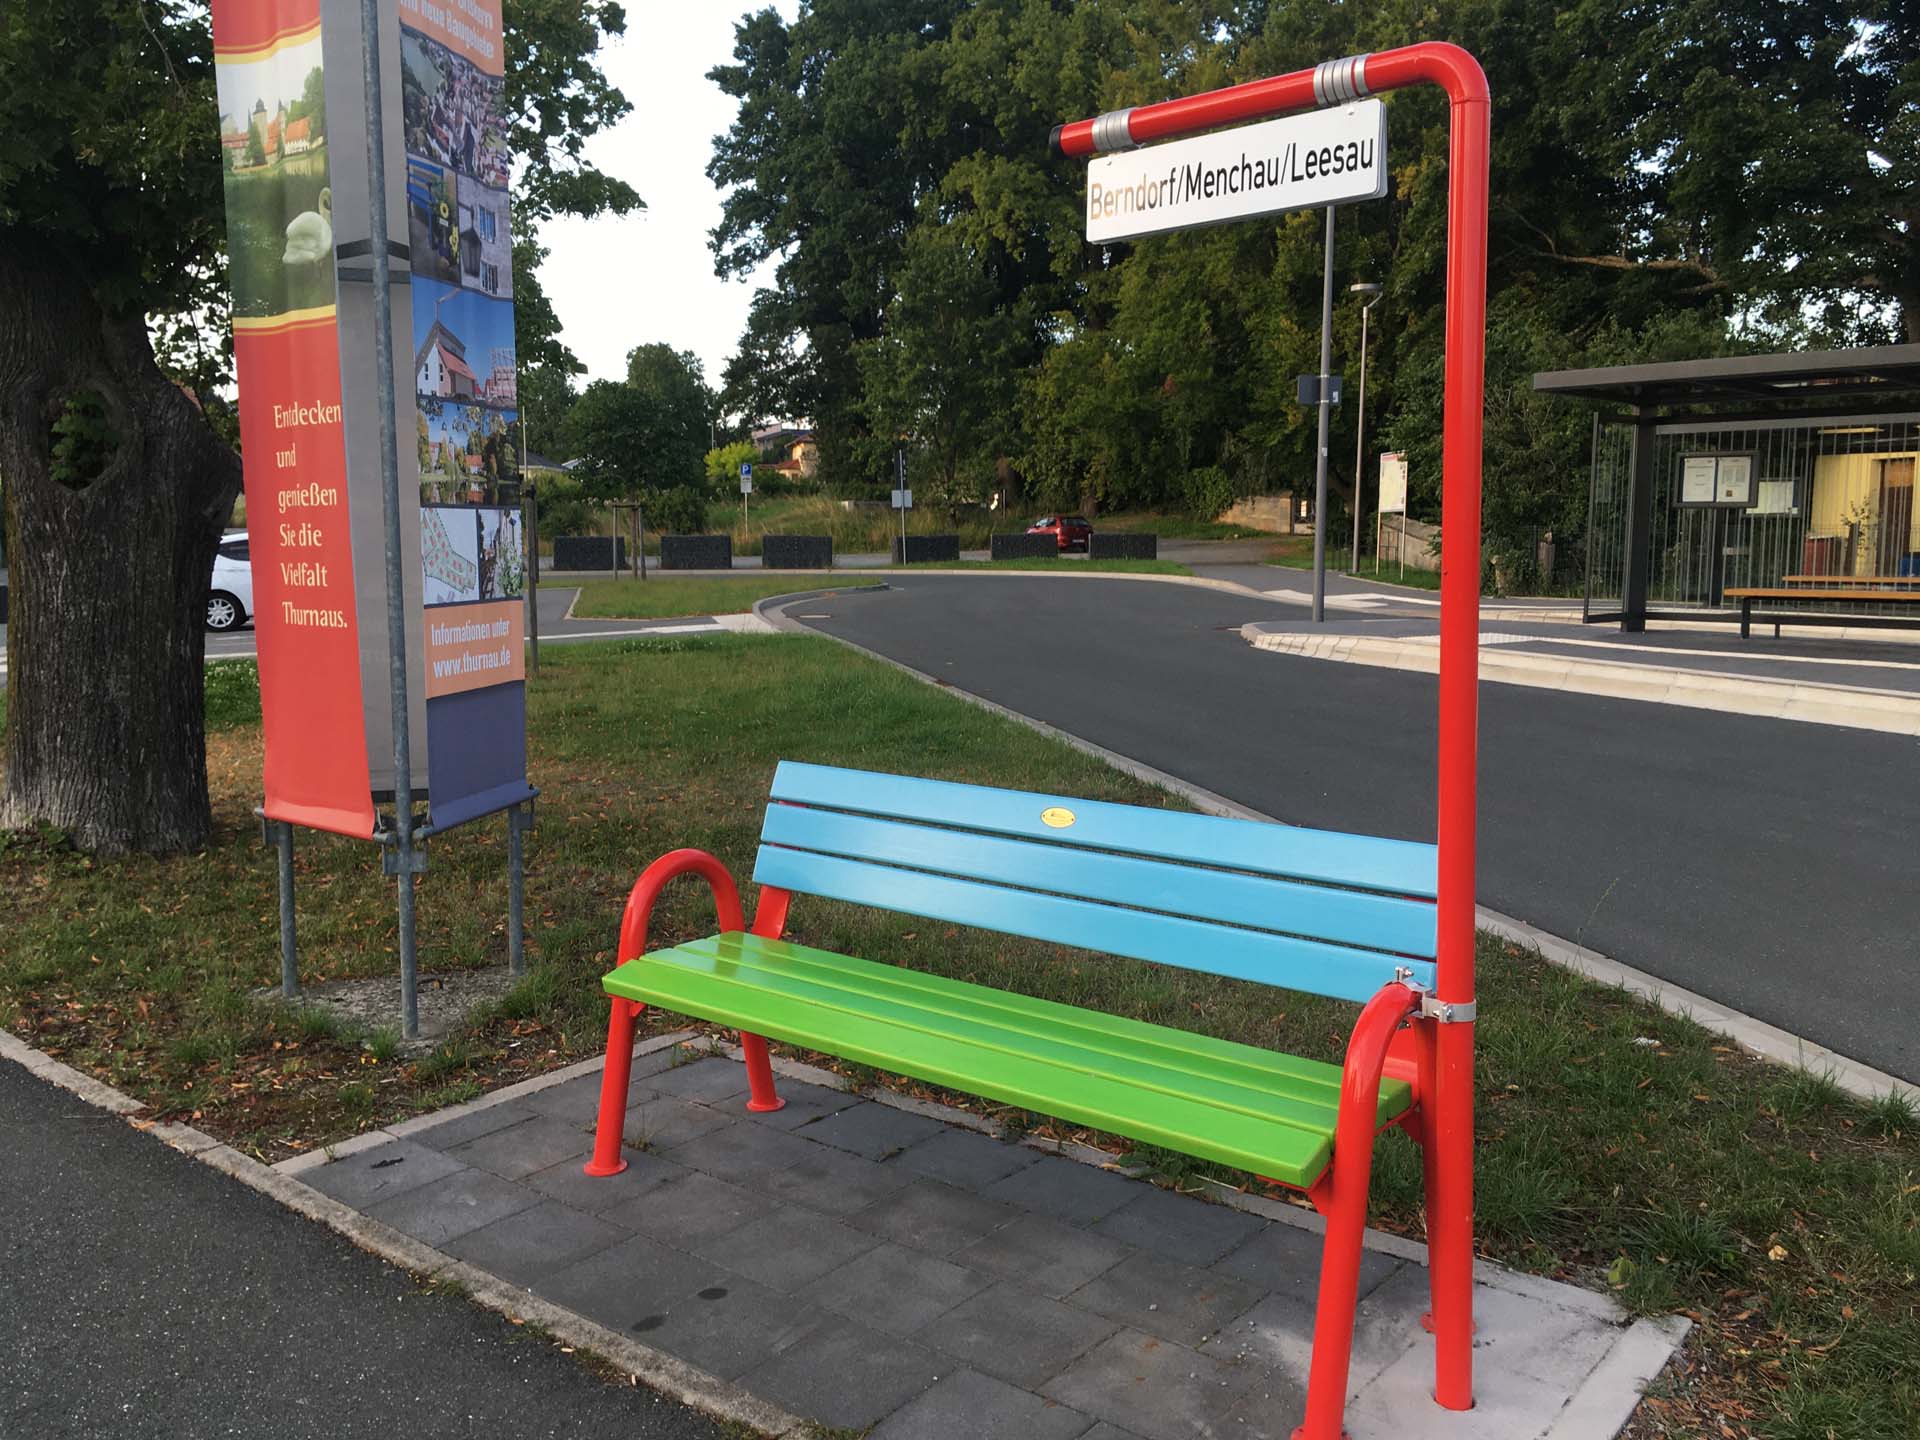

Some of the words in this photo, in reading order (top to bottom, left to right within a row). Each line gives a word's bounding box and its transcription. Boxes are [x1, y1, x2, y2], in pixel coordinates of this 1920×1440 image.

[1090, 138, 1374, 220] Berndorf/Menchau/Leesau
[273, 399, 342, 429] Entdecken
[276, 442, 296, 468] und
[742, 464, 749, 474] P
[278, 482, 338, 514] genießen
[279, 523, 296, 547] Sie
[298, 522, 323, 547] die
[280, 561, 328, 588] Vielfalt
[282, 601, 348, 629] Thurnaus.
[431, 619, 490, 647] Informationen
[491, 617, 510, 638] unter
[433, 644, 511, 679] www.thurnau.de
